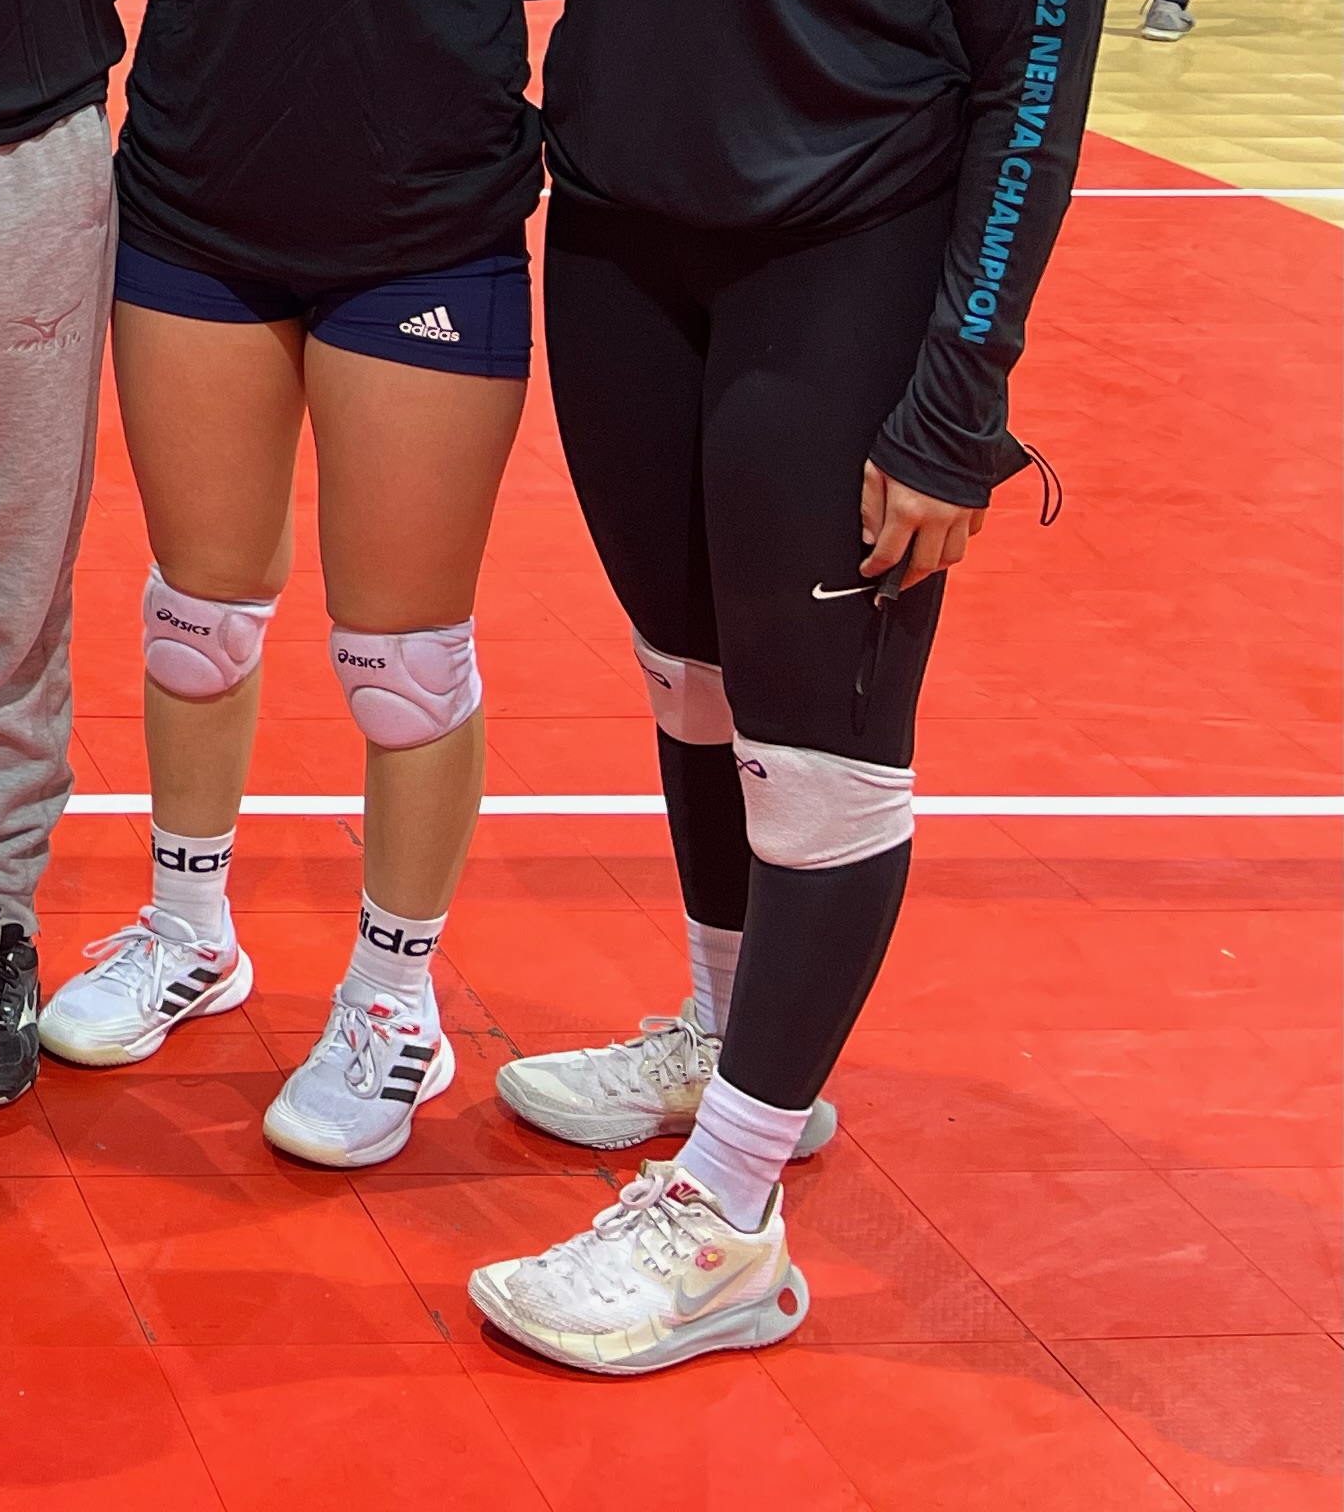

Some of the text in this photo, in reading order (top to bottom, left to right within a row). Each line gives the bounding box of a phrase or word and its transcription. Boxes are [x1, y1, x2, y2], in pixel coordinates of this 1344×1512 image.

[1008, 35, 1062, 148] NERVA
[959, 157, 1032, 345] CHAMPION
[399, 322, 460, 342] adidas
